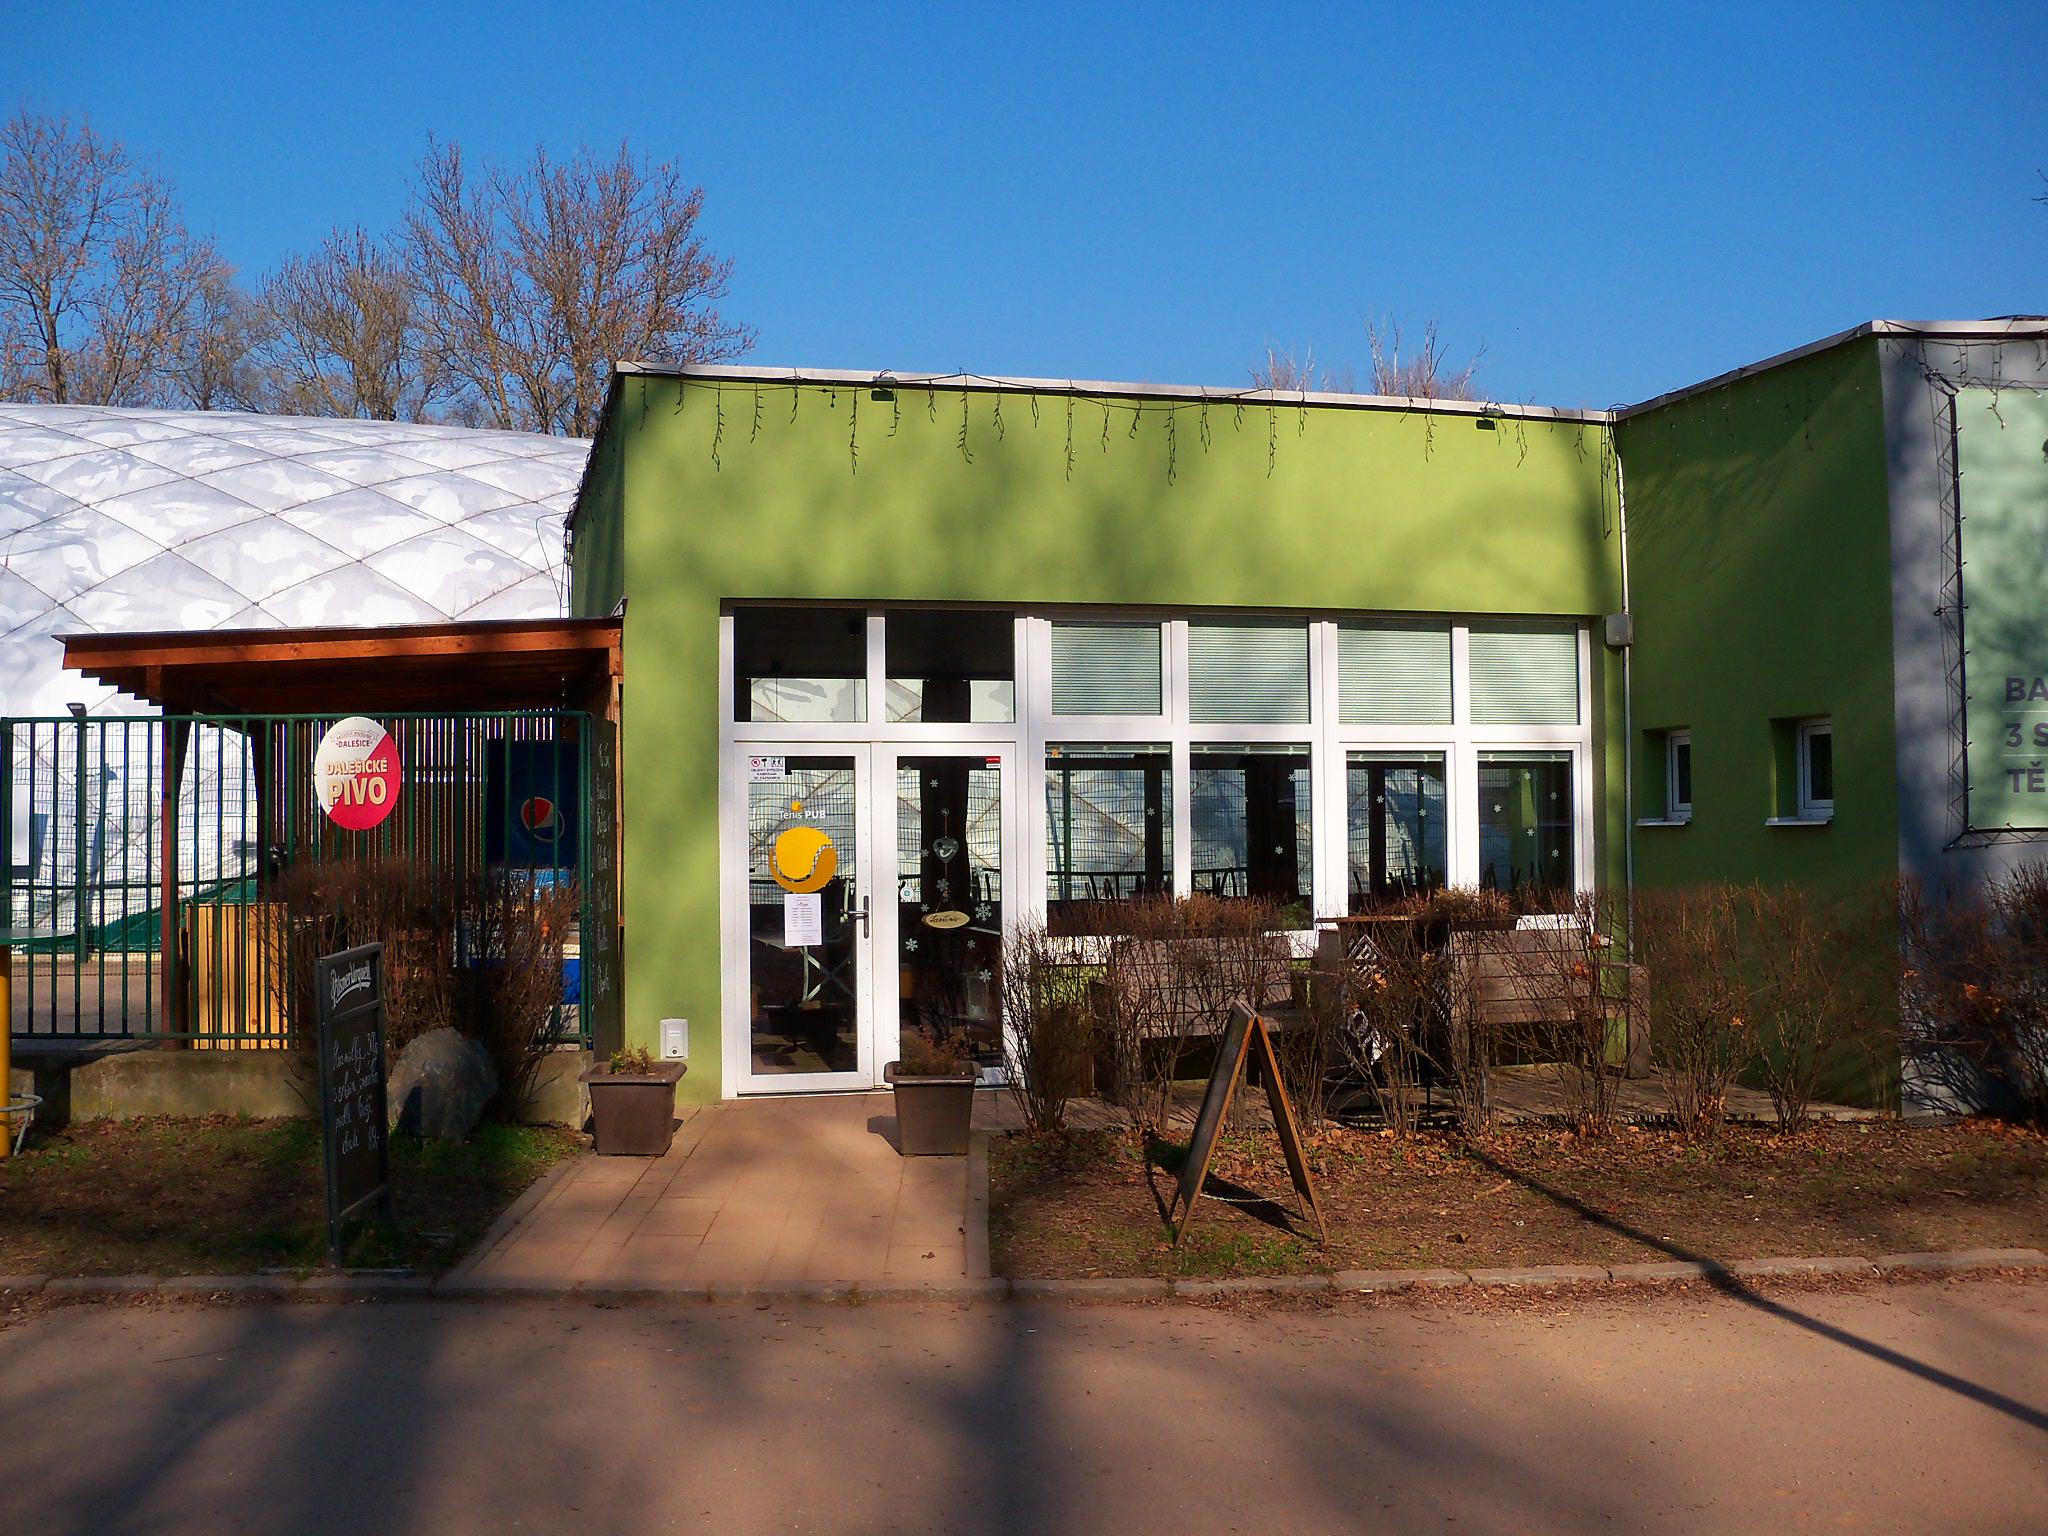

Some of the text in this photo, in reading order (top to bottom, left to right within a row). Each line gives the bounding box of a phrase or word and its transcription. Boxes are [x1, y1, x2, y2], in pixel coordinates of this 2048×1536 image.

[2006, 677, 2048, 702] BA
[2006, 723, 2022, 748] 3
[326, 757, 388, 775] DALEŠICKÉ
[2006, 761, 2046, 793] TĚ
[327, 776, 387, 806] PIVO
[779, 810, 826, 819] Tenis PUB
